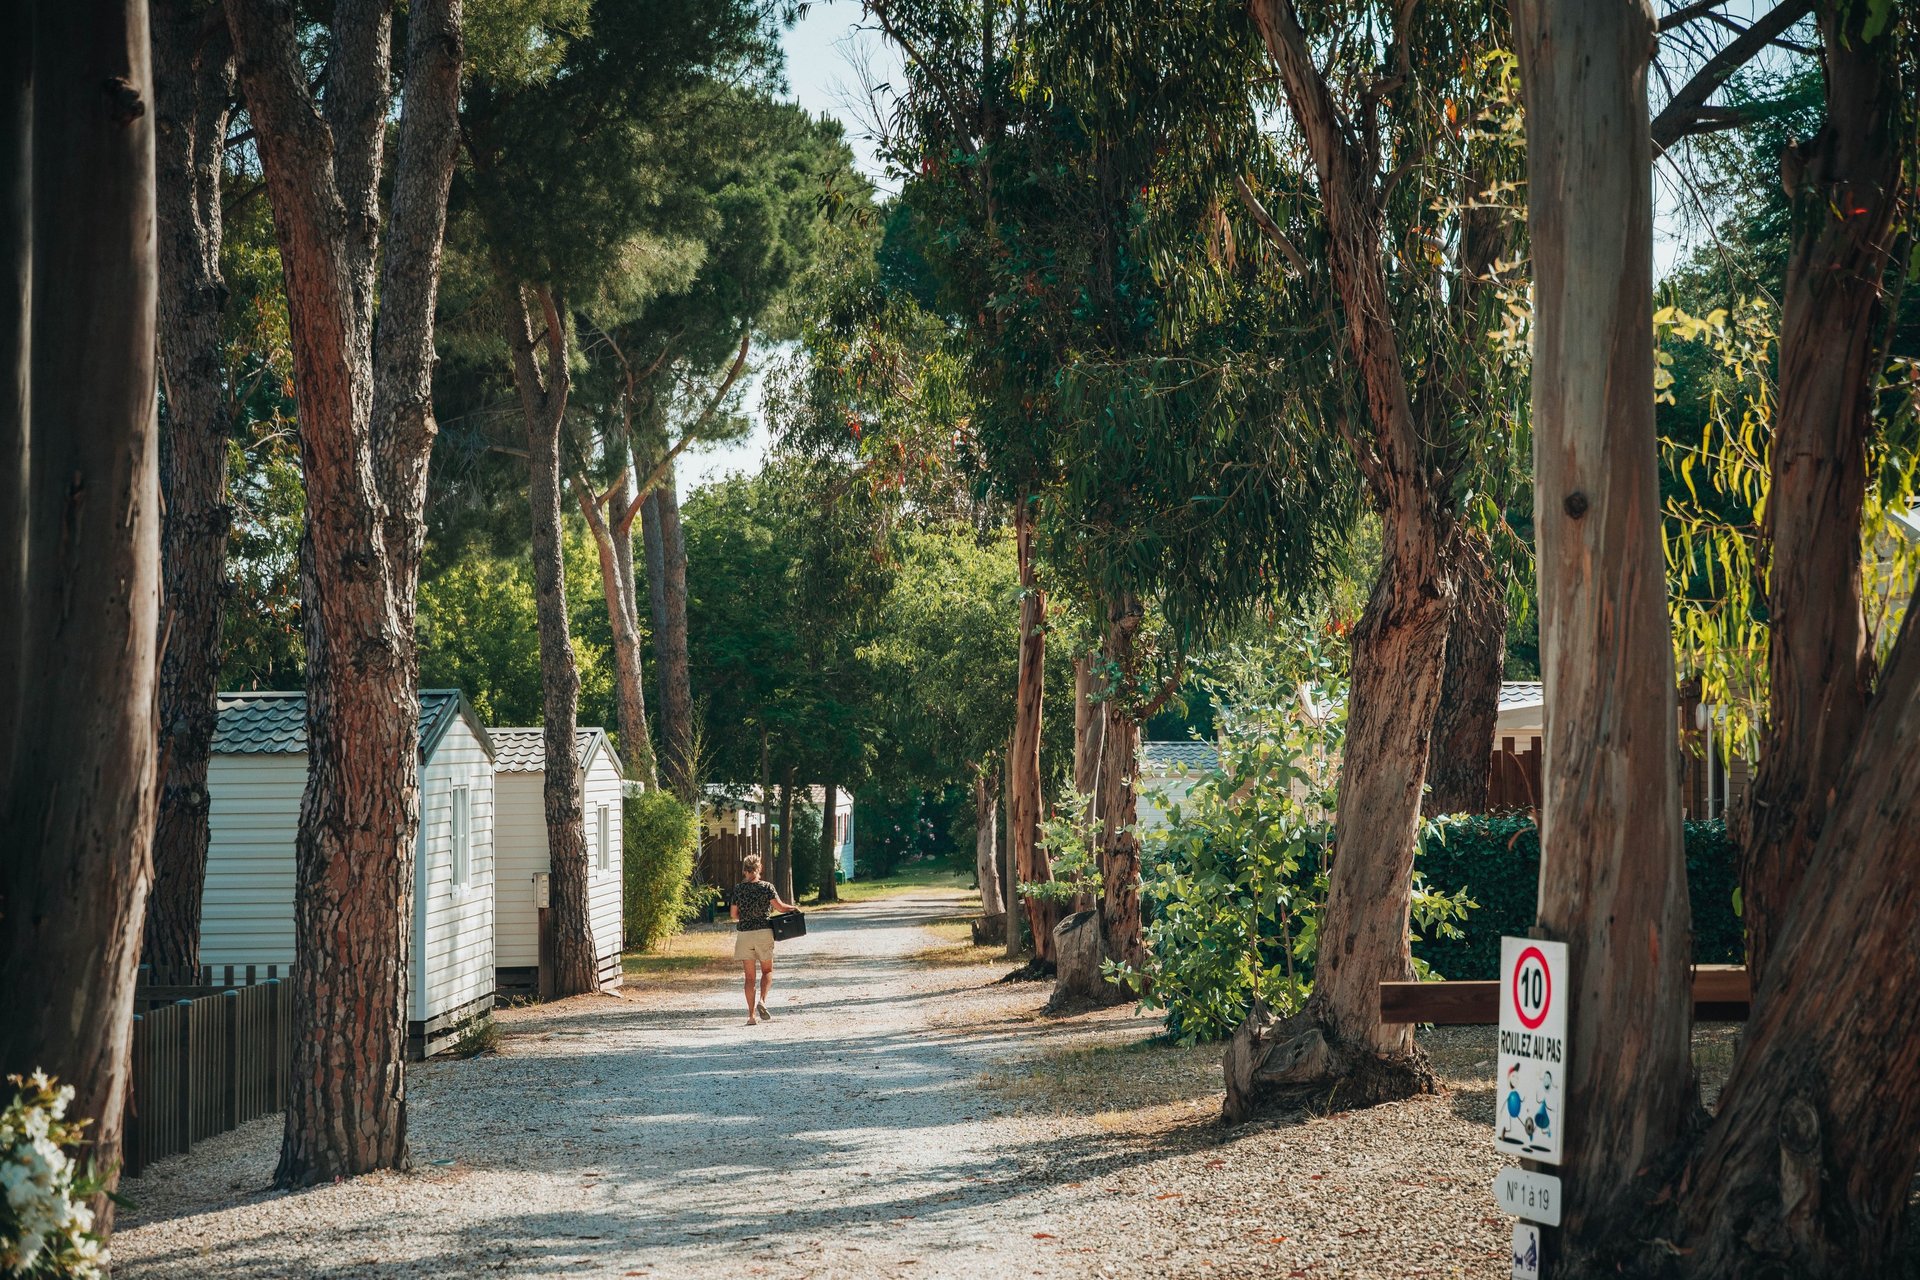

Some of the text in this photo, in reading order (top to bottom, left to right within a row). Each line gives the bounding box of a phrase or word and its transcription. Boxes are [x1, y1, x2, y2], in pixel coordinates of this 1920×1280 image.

[1521, 967, 1542, 1009] 10
[1501, 1030, 1561, 1063] ROULEZ AU PAS
[1506, 1180, 1549, 1210] N° 1 à 19
